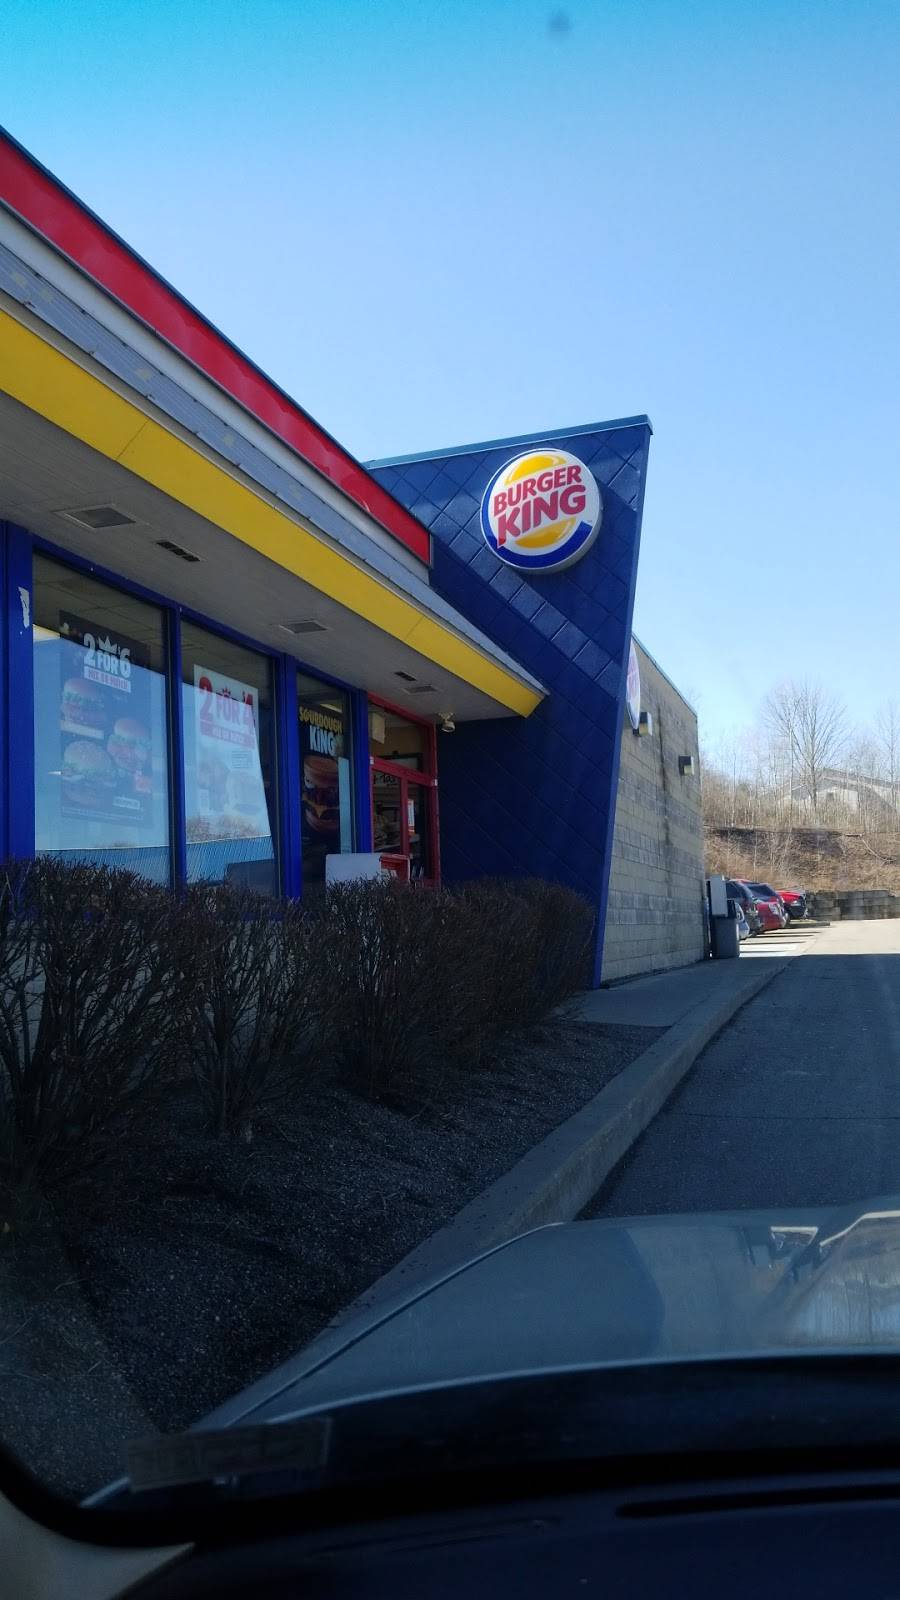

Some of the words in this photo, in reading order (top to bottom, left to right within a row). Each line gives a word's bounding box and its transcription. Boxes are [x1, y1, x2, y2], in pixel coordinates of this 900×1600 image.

[493, 465, 582, 516] BURGER
[497, 484, 586, 547] KING
[83, 632, 96, 667] 2
[96, 649, 119, 675] FOR
[198, 675, 213, 722] 2
[215, 693, 241, 726] FOR
[299, 704, 343, 735] SOURDOUGH
